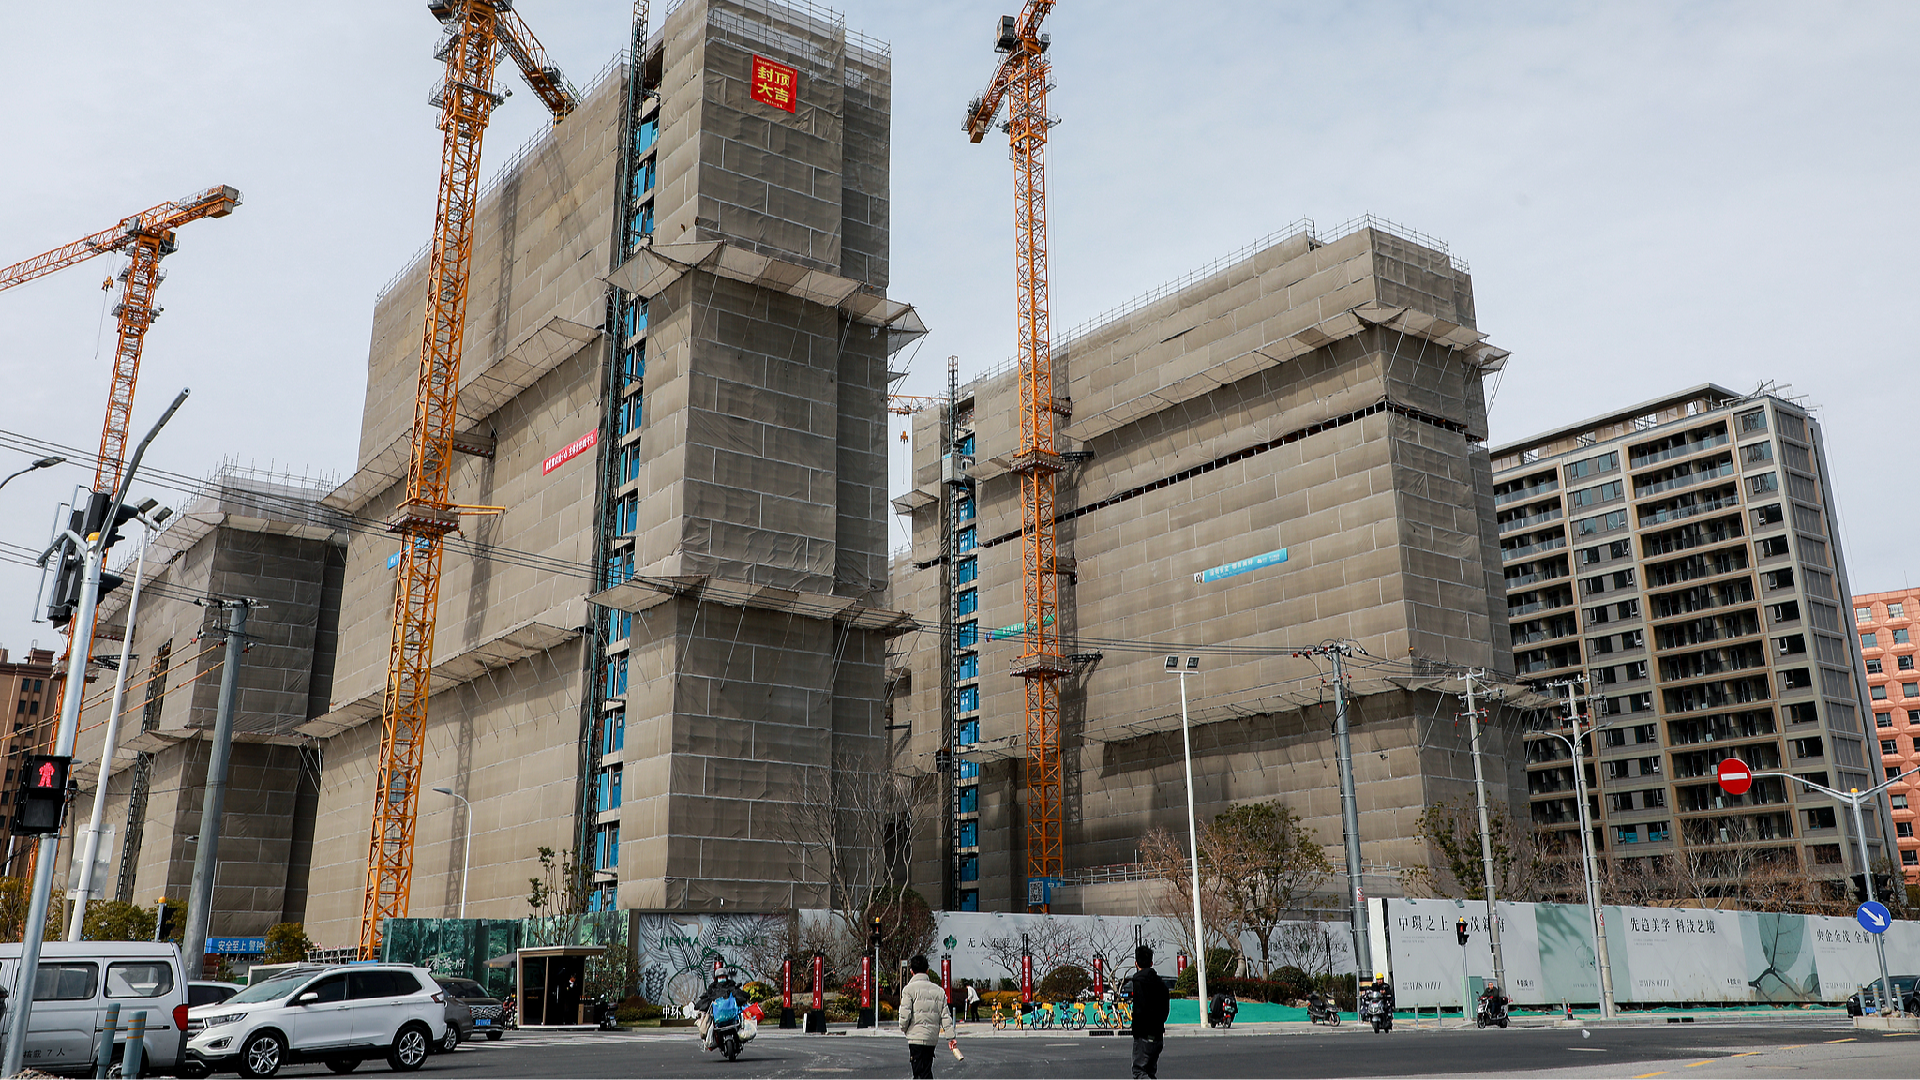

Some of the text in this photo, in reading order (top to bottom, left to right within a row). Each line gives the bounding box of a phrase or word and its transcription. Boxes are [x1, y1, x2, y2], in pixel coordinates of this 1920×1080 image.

[757, 66, 790, 88] 封顶
[757, 82, 789, 103] 大吉
[217, 940, 267, 952] 安全至上 警钟
[662, 1004, 682, 1020] 中环
[47, 1049, 53, 1057] 7
[56, 1047, 66, 1057] 人
